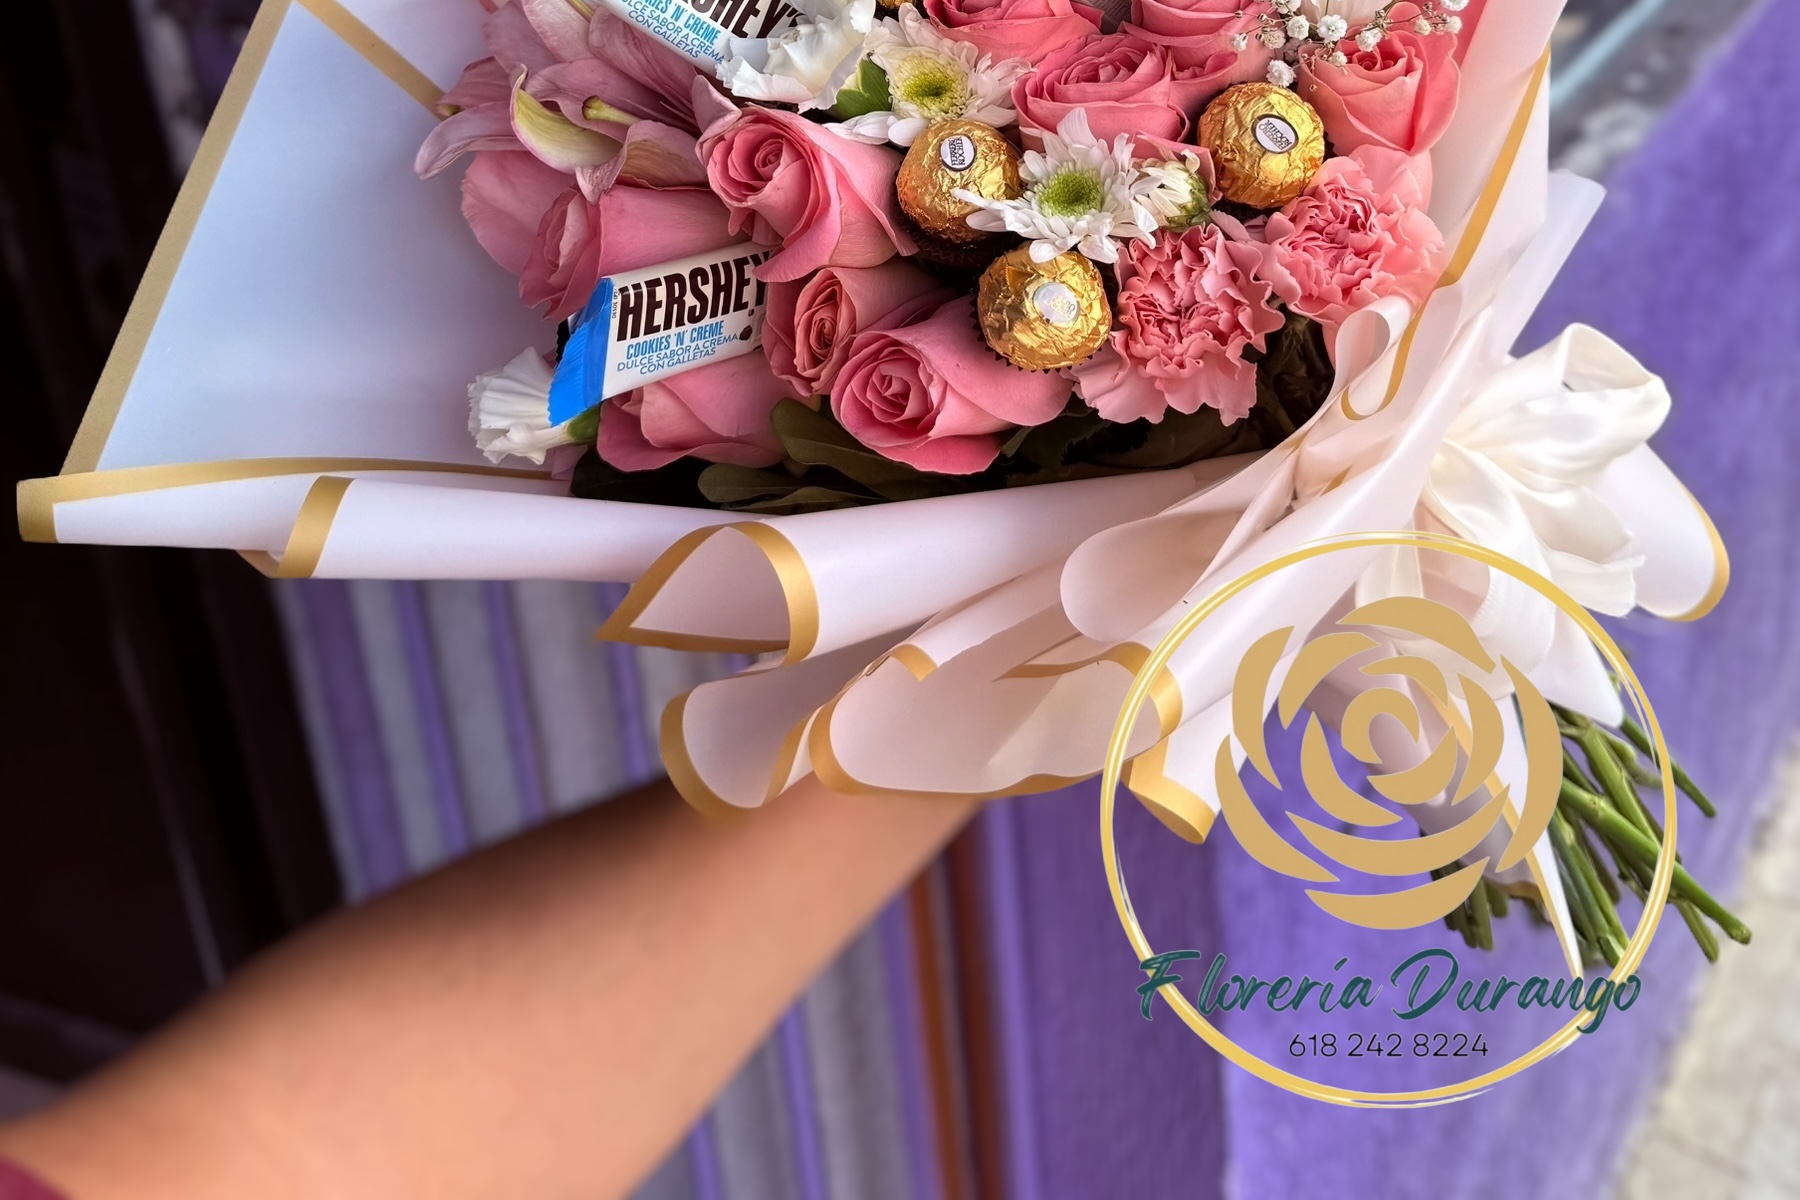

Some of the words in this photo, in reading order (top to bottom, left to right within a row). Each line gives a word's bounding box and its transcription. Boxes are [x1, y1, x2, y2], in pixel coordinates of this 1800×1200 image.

[627, 9, 653, 28] CON
[652, 24, 700, 58] GALLETAS
[647, 9, 682, 36] SABOR
[681, 31, 690, 42] A
[688, 36, 724, 64] CREMA
[667, 3, 687, 24] 'N'
[683, 13, 720, 45] CREME
[1265, 119, 1292, 147] ROCHER
[617, 354, 653, 372] DULCE
[654, 344, 692, 362] SABOR
[692, 341, 701, 352] A
[700, 332, 739, 350] CREMA
[626, 333, 671, 360] COOKIES
[673, 328, 688, 347] 'N'
[689, 319, 724, 343] CREME
[640, 359, 667, 375] CON
[666, 345, 716, 368] GALLETAS
